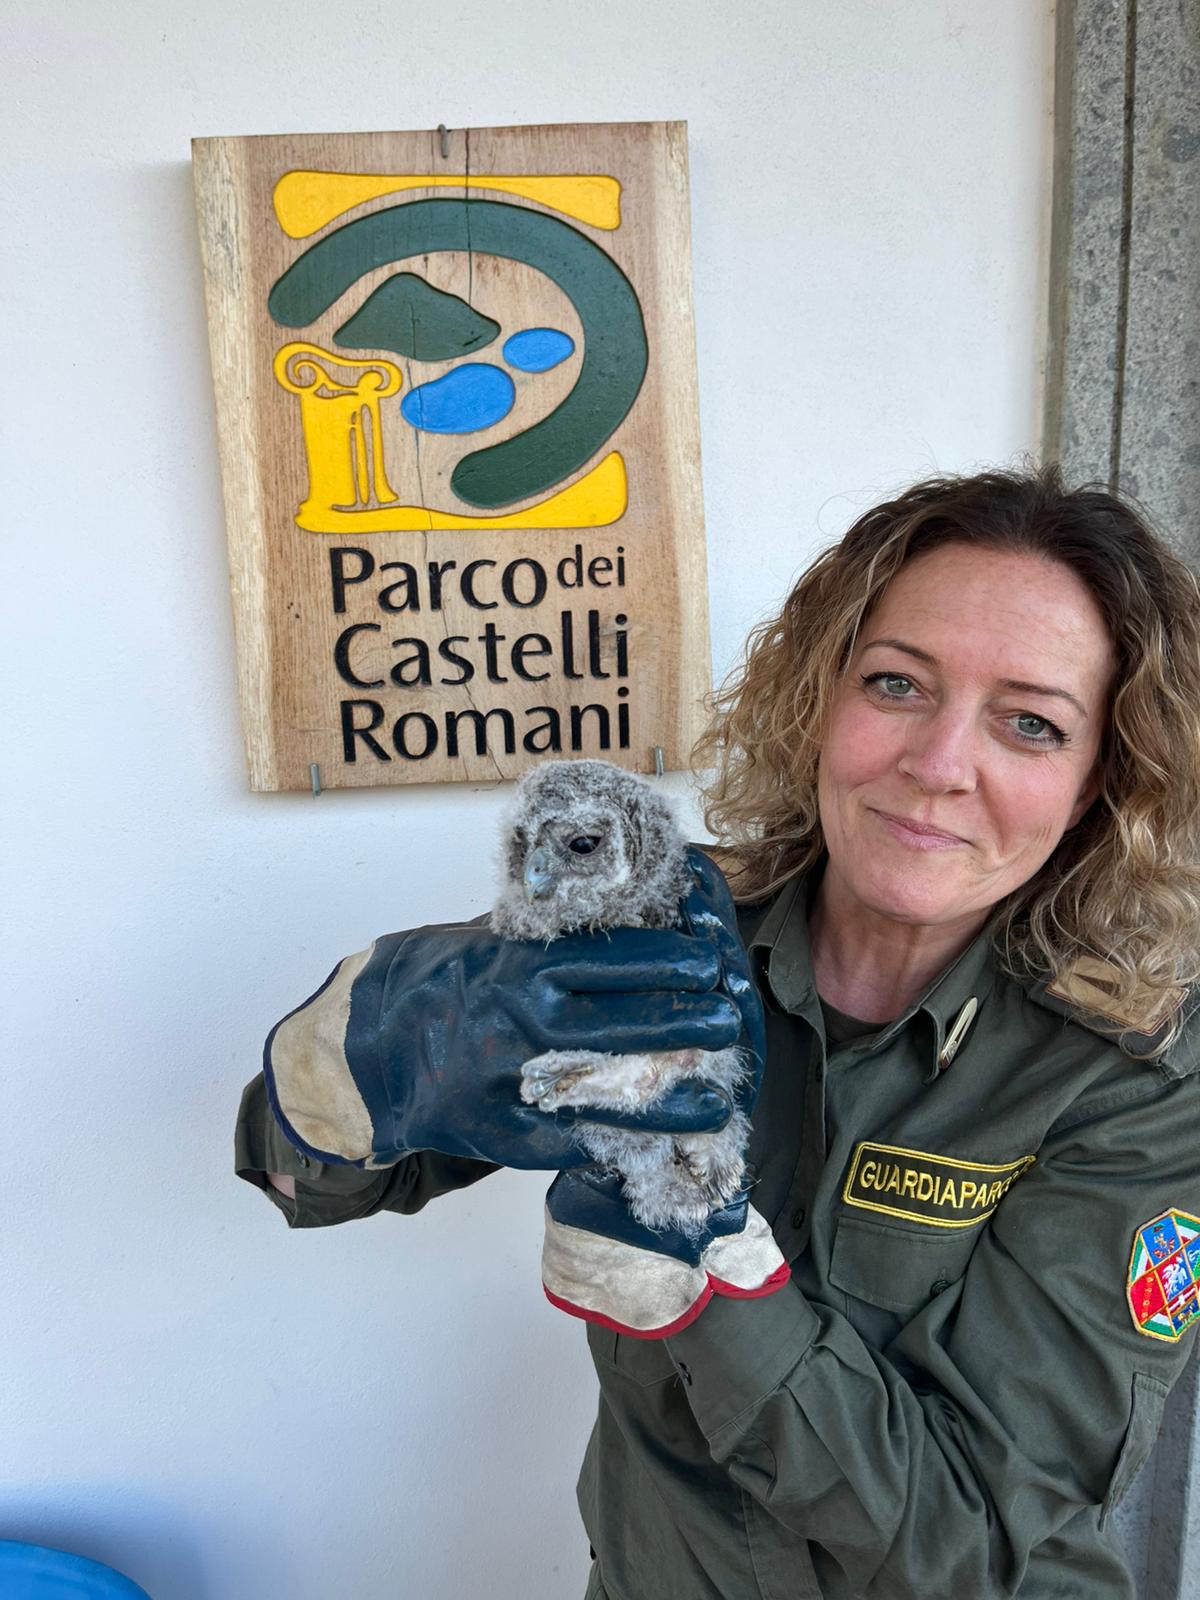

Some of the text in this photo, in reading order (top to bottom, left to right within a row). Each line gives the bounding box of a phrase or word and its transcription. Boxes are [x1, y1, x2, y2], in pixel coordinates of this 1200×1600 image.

[329, 544, 626, 614] Parco dei
[333, 609, 629, 689] Castelli
[340, 686, 631, 763] Romani
